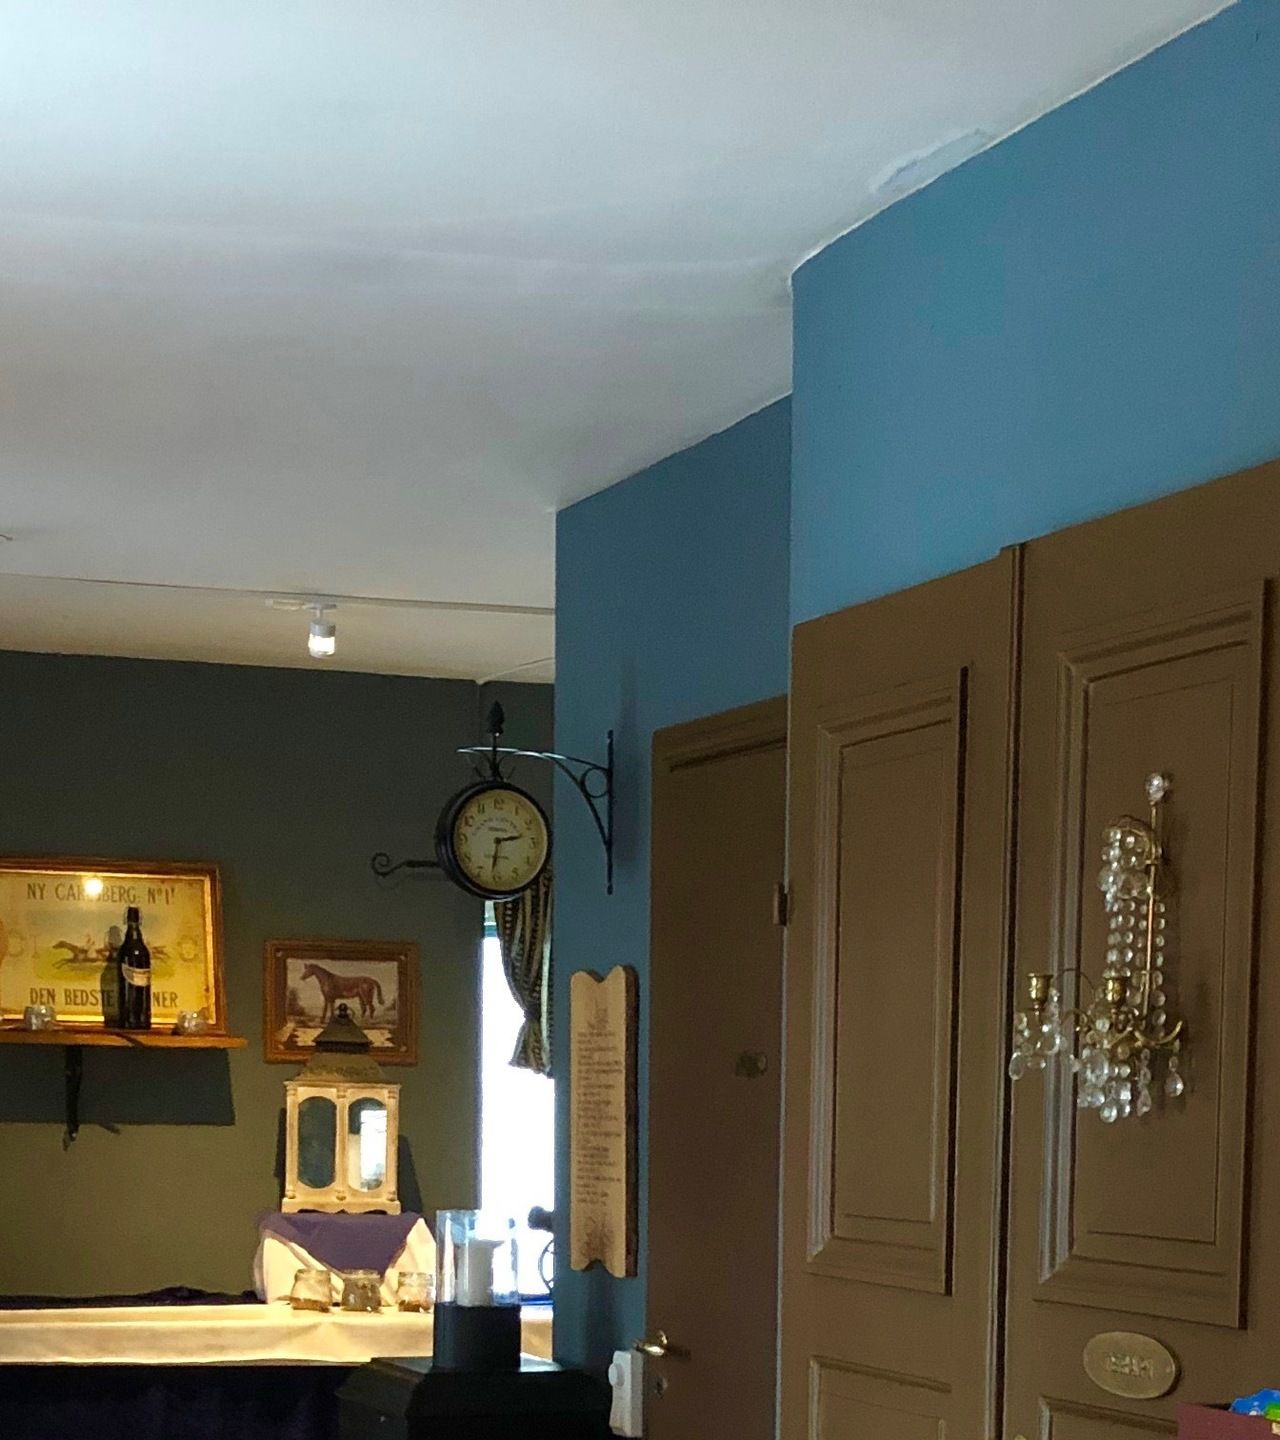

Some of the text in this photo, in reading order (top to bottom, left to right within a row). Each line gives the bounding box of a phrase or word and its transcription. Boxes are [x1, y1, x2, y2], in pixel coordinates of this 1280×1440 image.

[27, 882, 46, 900] NY
[29, 987, 56, 1006] DEN
[64, 988, 115, 1008] BEDSTE
